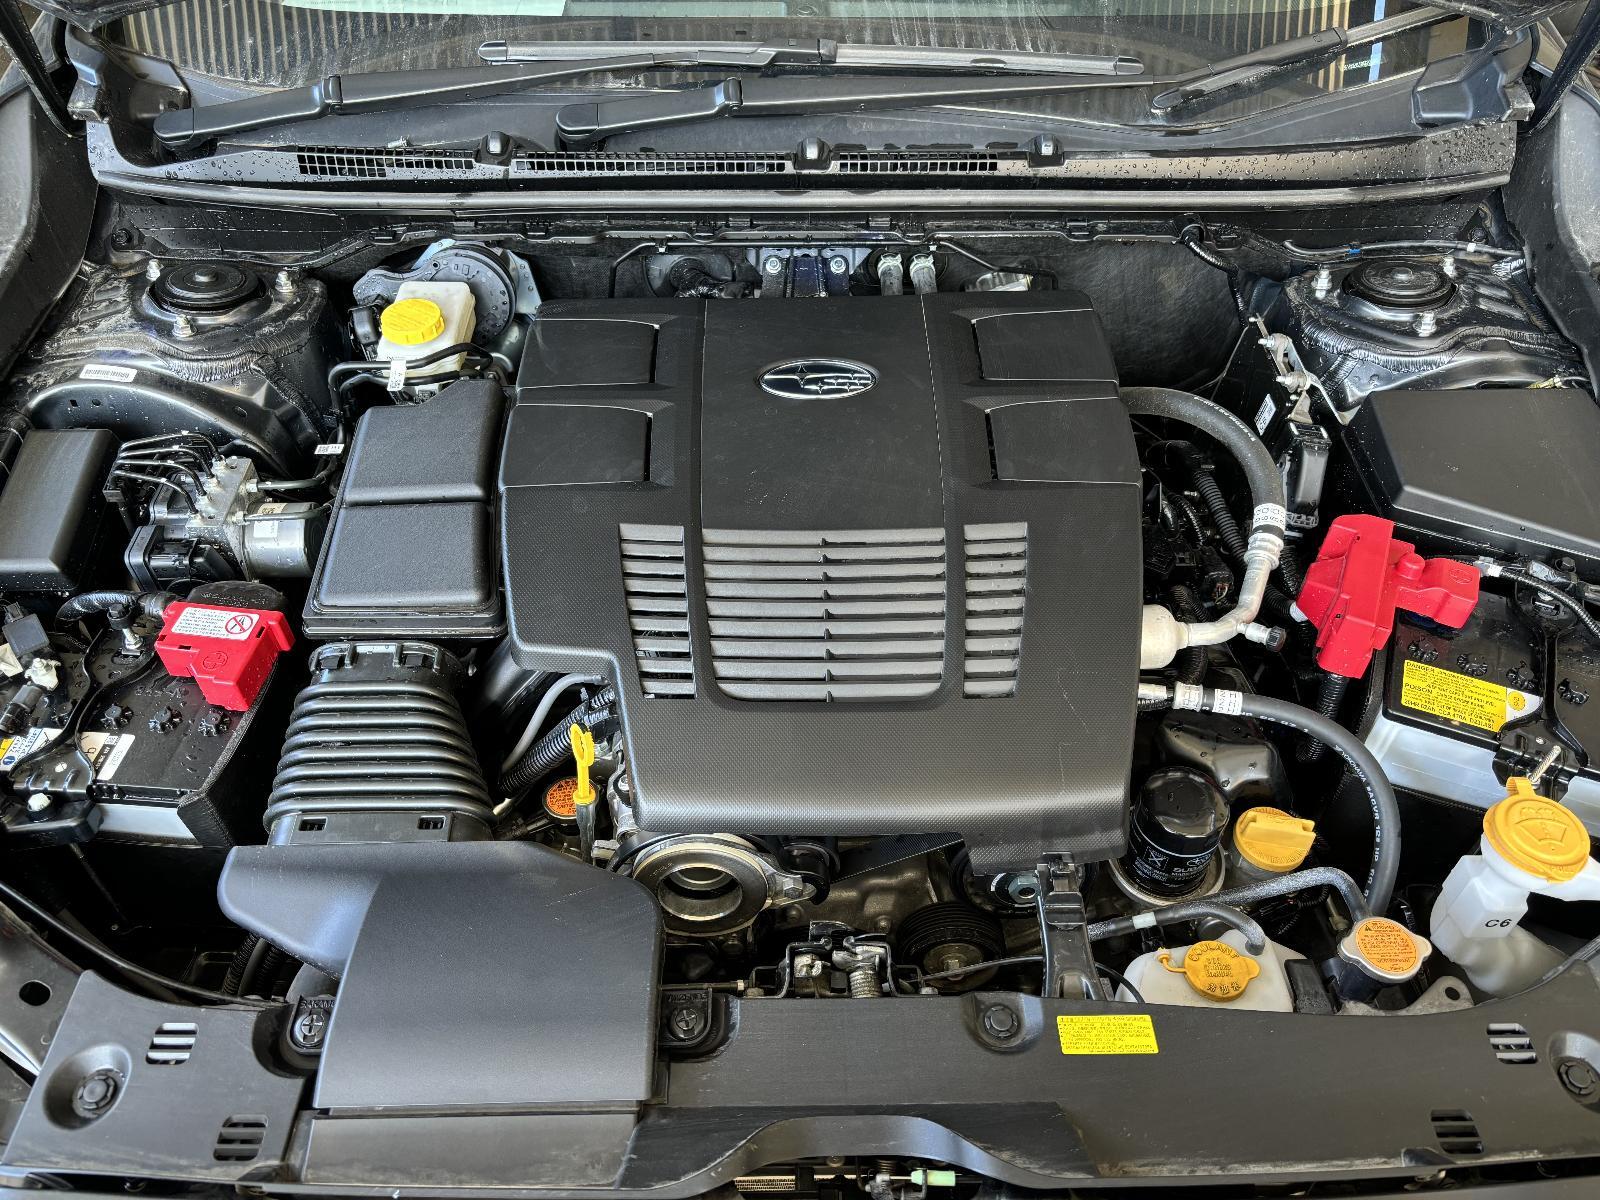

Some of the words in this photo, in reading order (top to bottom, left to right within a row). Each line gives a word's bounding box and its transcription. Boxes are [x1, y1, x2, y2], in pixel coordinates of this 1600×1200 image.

[1406, 661, 1434, 673] DANGER
[1404, 682, 1432, 694] POISON
[1341, 752, 1367, 783] YOKOHAMA
[1485, 918, 1512, 928] C6
[1188, 943, 1240, 961] COOLANT
